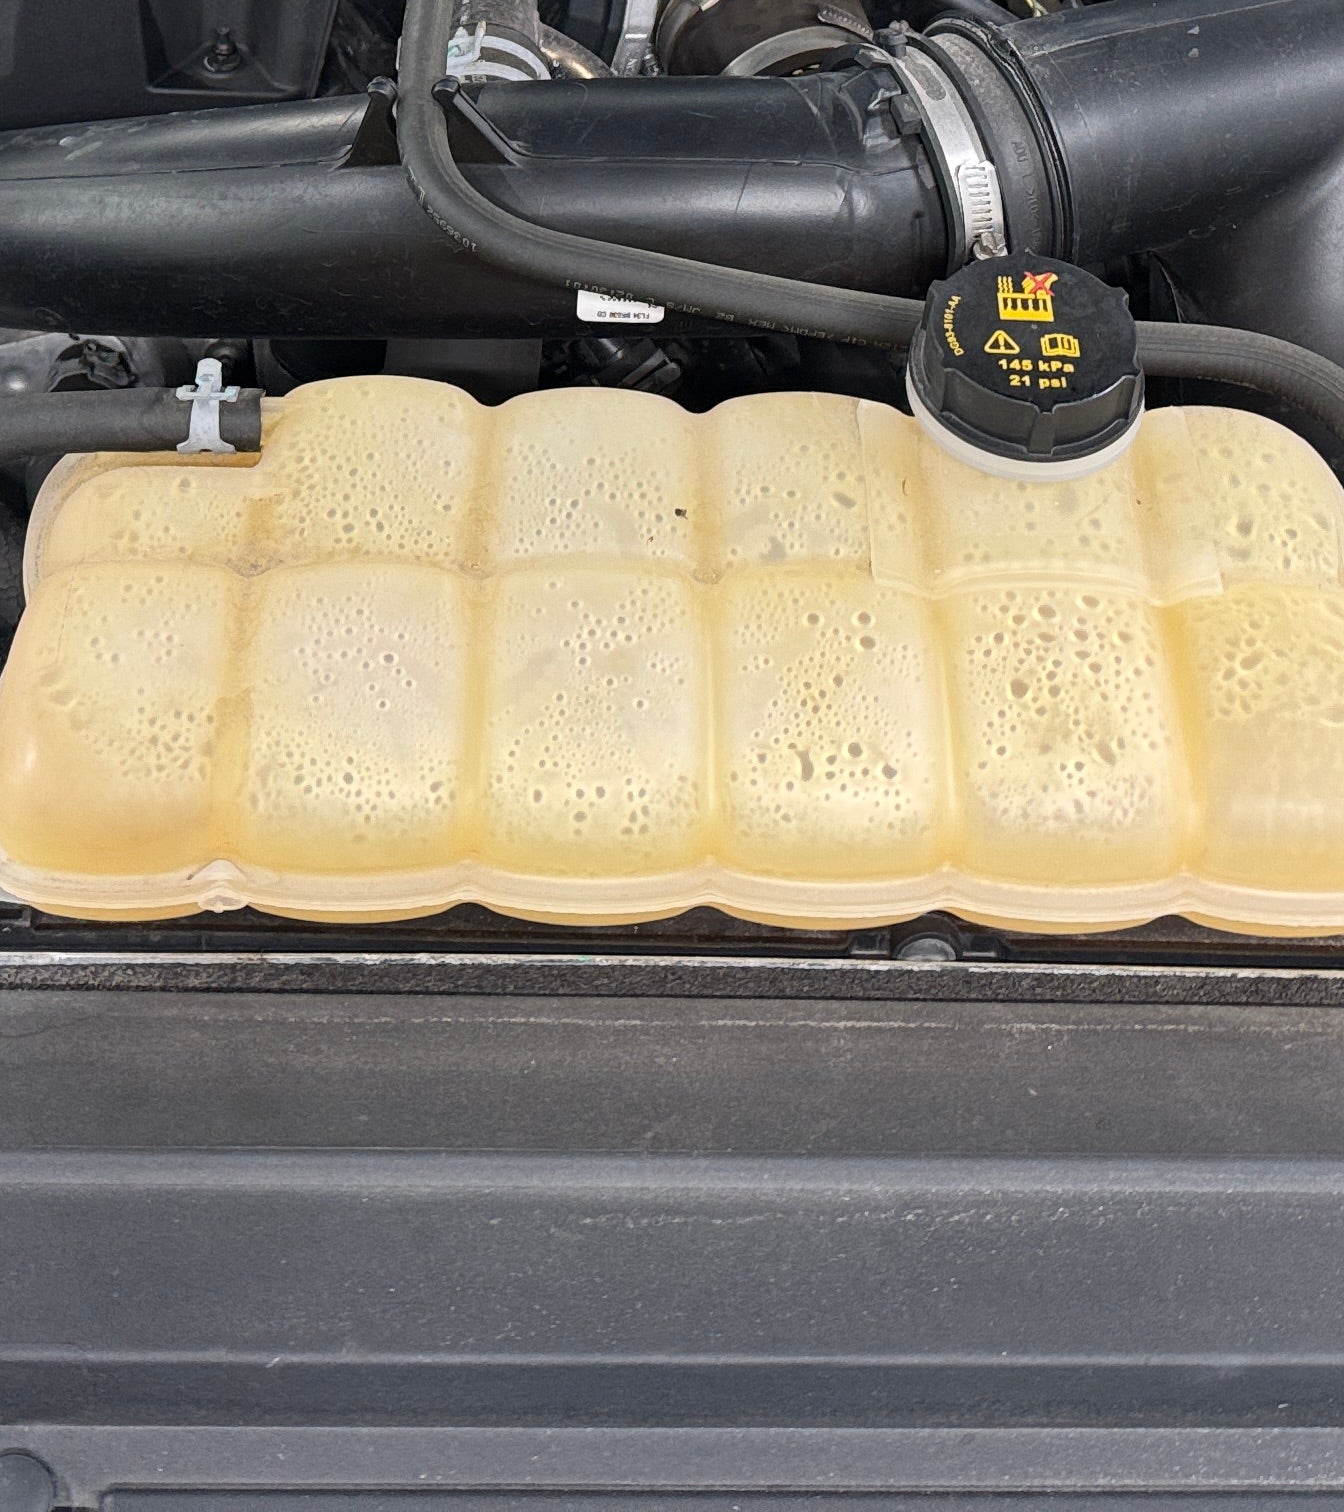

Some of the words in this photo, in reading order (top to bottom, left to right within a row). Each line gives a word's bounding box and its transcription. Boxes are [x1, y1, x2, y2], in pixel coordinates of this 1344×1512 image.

[998, 358, 1033, 372] 145
[1038, 358, 1076, 374] kPa
[1008, 374, 1031, 387] 21
[1038, 375, 1068, 390] psi
